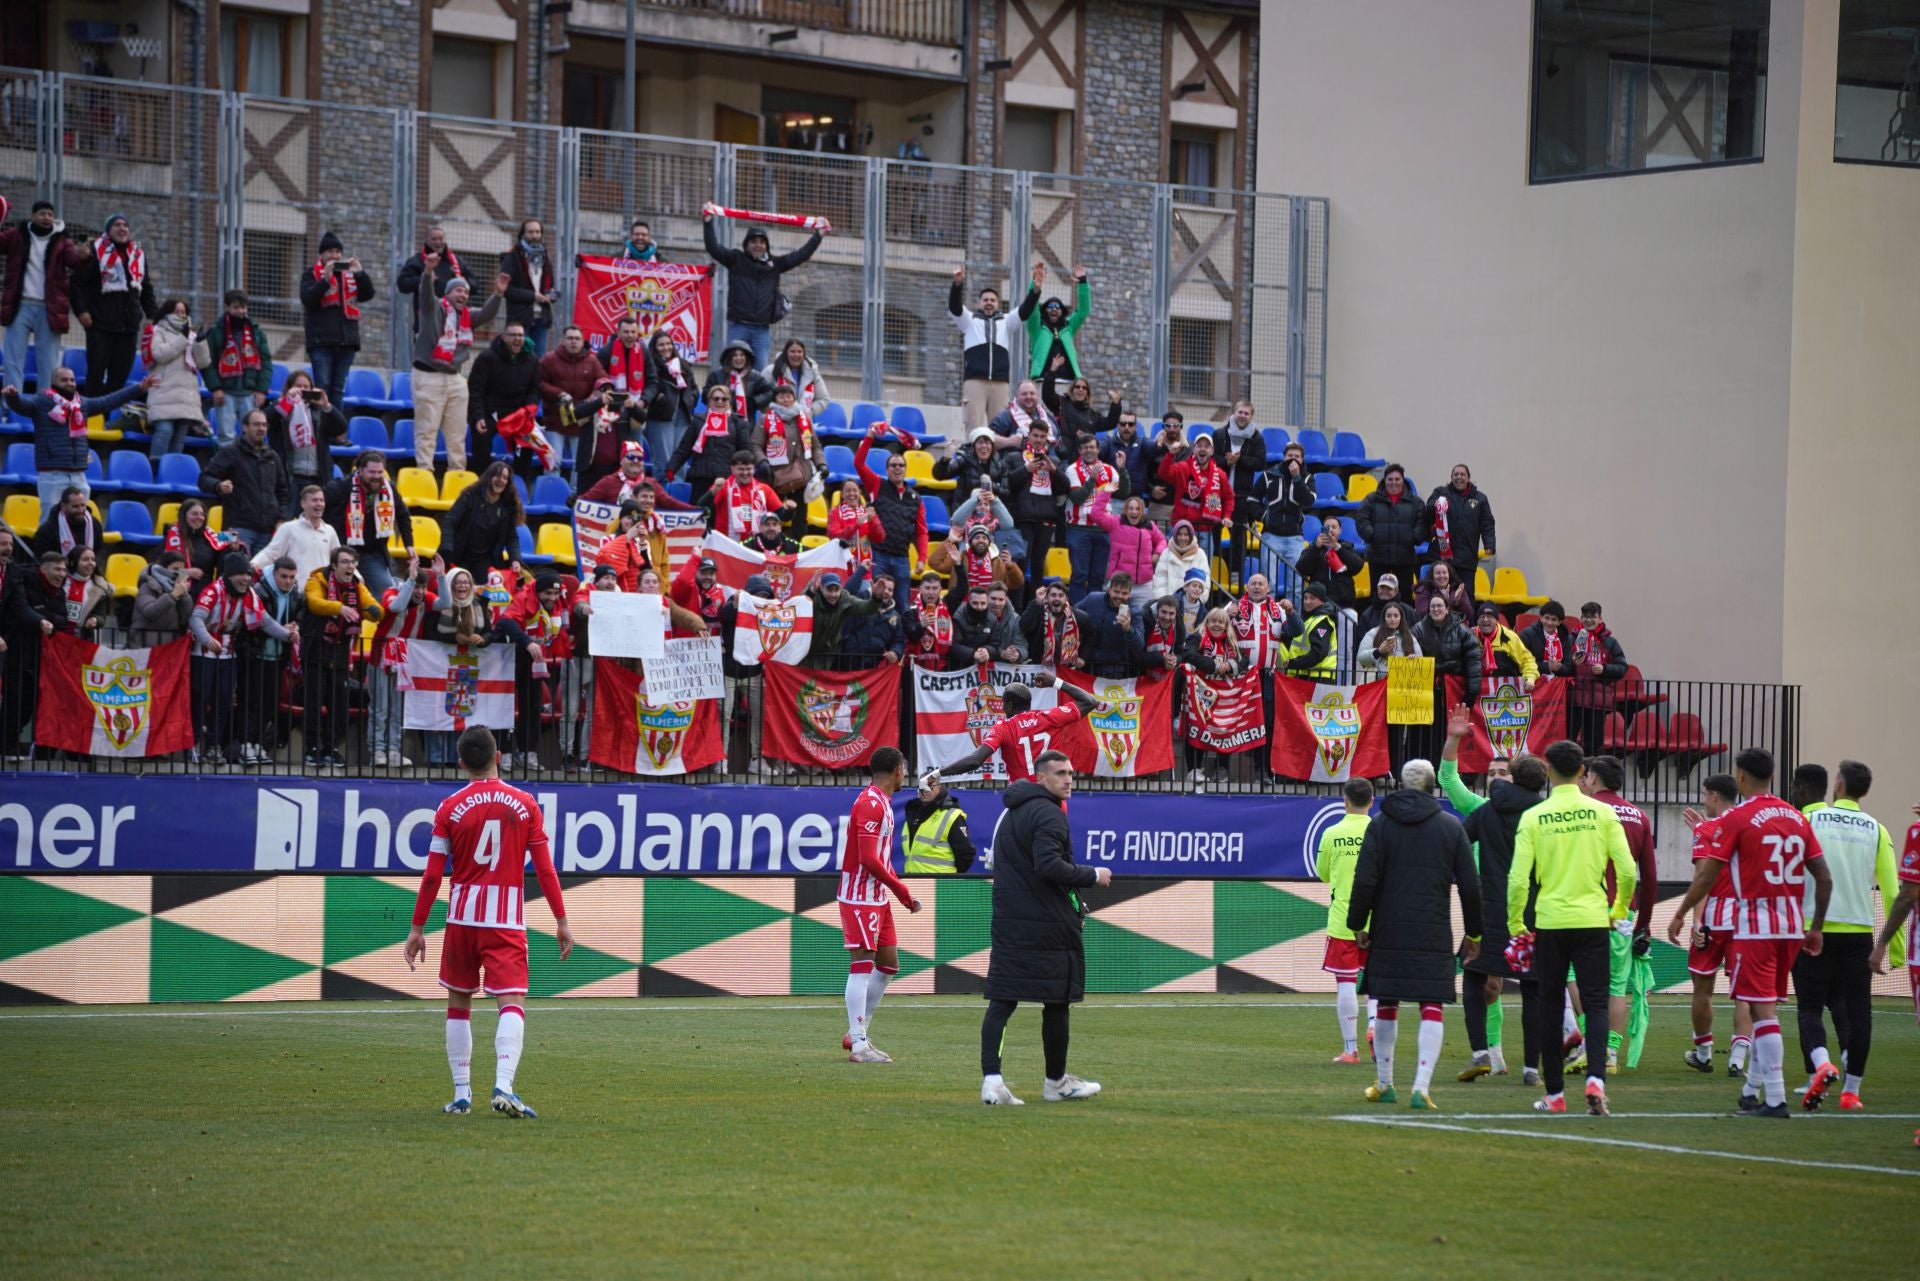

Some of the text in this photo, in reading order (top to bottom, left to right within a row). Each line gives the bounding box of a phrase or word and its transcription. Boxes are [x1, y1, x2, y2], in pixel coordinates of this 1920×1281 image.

[630, 303, 665, 311] ALMERIA
[90, 672, 142, 687] U D
[920, 671, 984, 691] CAPITAL
[92, 692, 144, 705] ALMERIA
[1125, 702, 1136, 712] D
[1487, 702, 1525, 712] U D
[642, 714, 689, 727] ALMERIA
[1094, 717, 1136, 729] ALMERIA
[1491, 717, 1526, 726] ALMERIA
[819, 735, 870, 762] MOLINOS
[1018, 731, 1052, 776] 17
[449, 791, 530, 824] NELSON MONTE
[1612, 804, 1642, 818] cron
[1538, 809, 1596, 825] macron
[1750, 806, 1779, 829] PEDRO
[1817, 812, 1875, 831] macron
[473, 819, 501, 872] 4
[1085, 830, 1244, 862] FC ANDORRA
[1333, 836, 1363, 848] mac
[1761, 834, 1806, 885] 32
